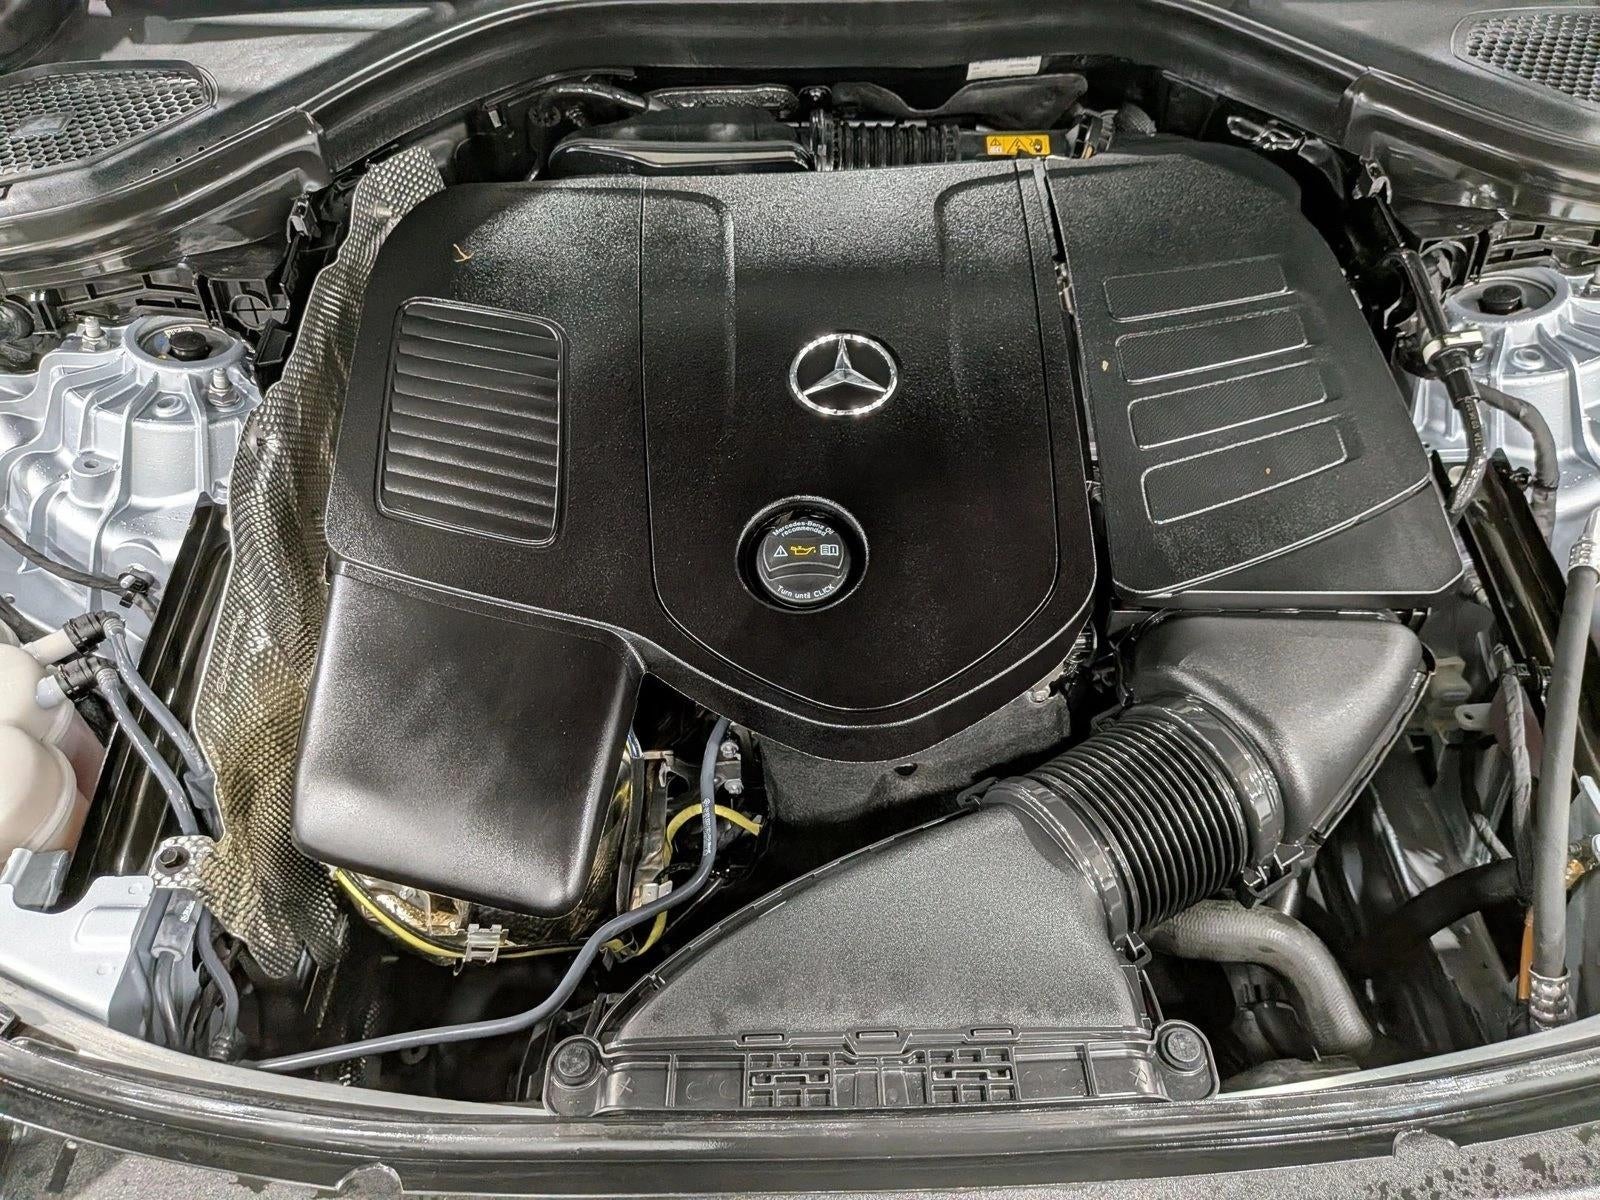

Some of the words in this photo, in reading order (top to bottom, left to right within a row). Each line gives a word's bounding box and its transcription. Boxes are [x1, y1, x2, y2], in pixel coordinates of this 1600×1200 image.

[772, 521, 824, 536] Mercedes-Benz
[825, 527, 835, 535] Oil
[781, 526, 826, 537] recommended
[777, 585, 792, 597] Turn
[813, 584, 835, 597] CLICK
